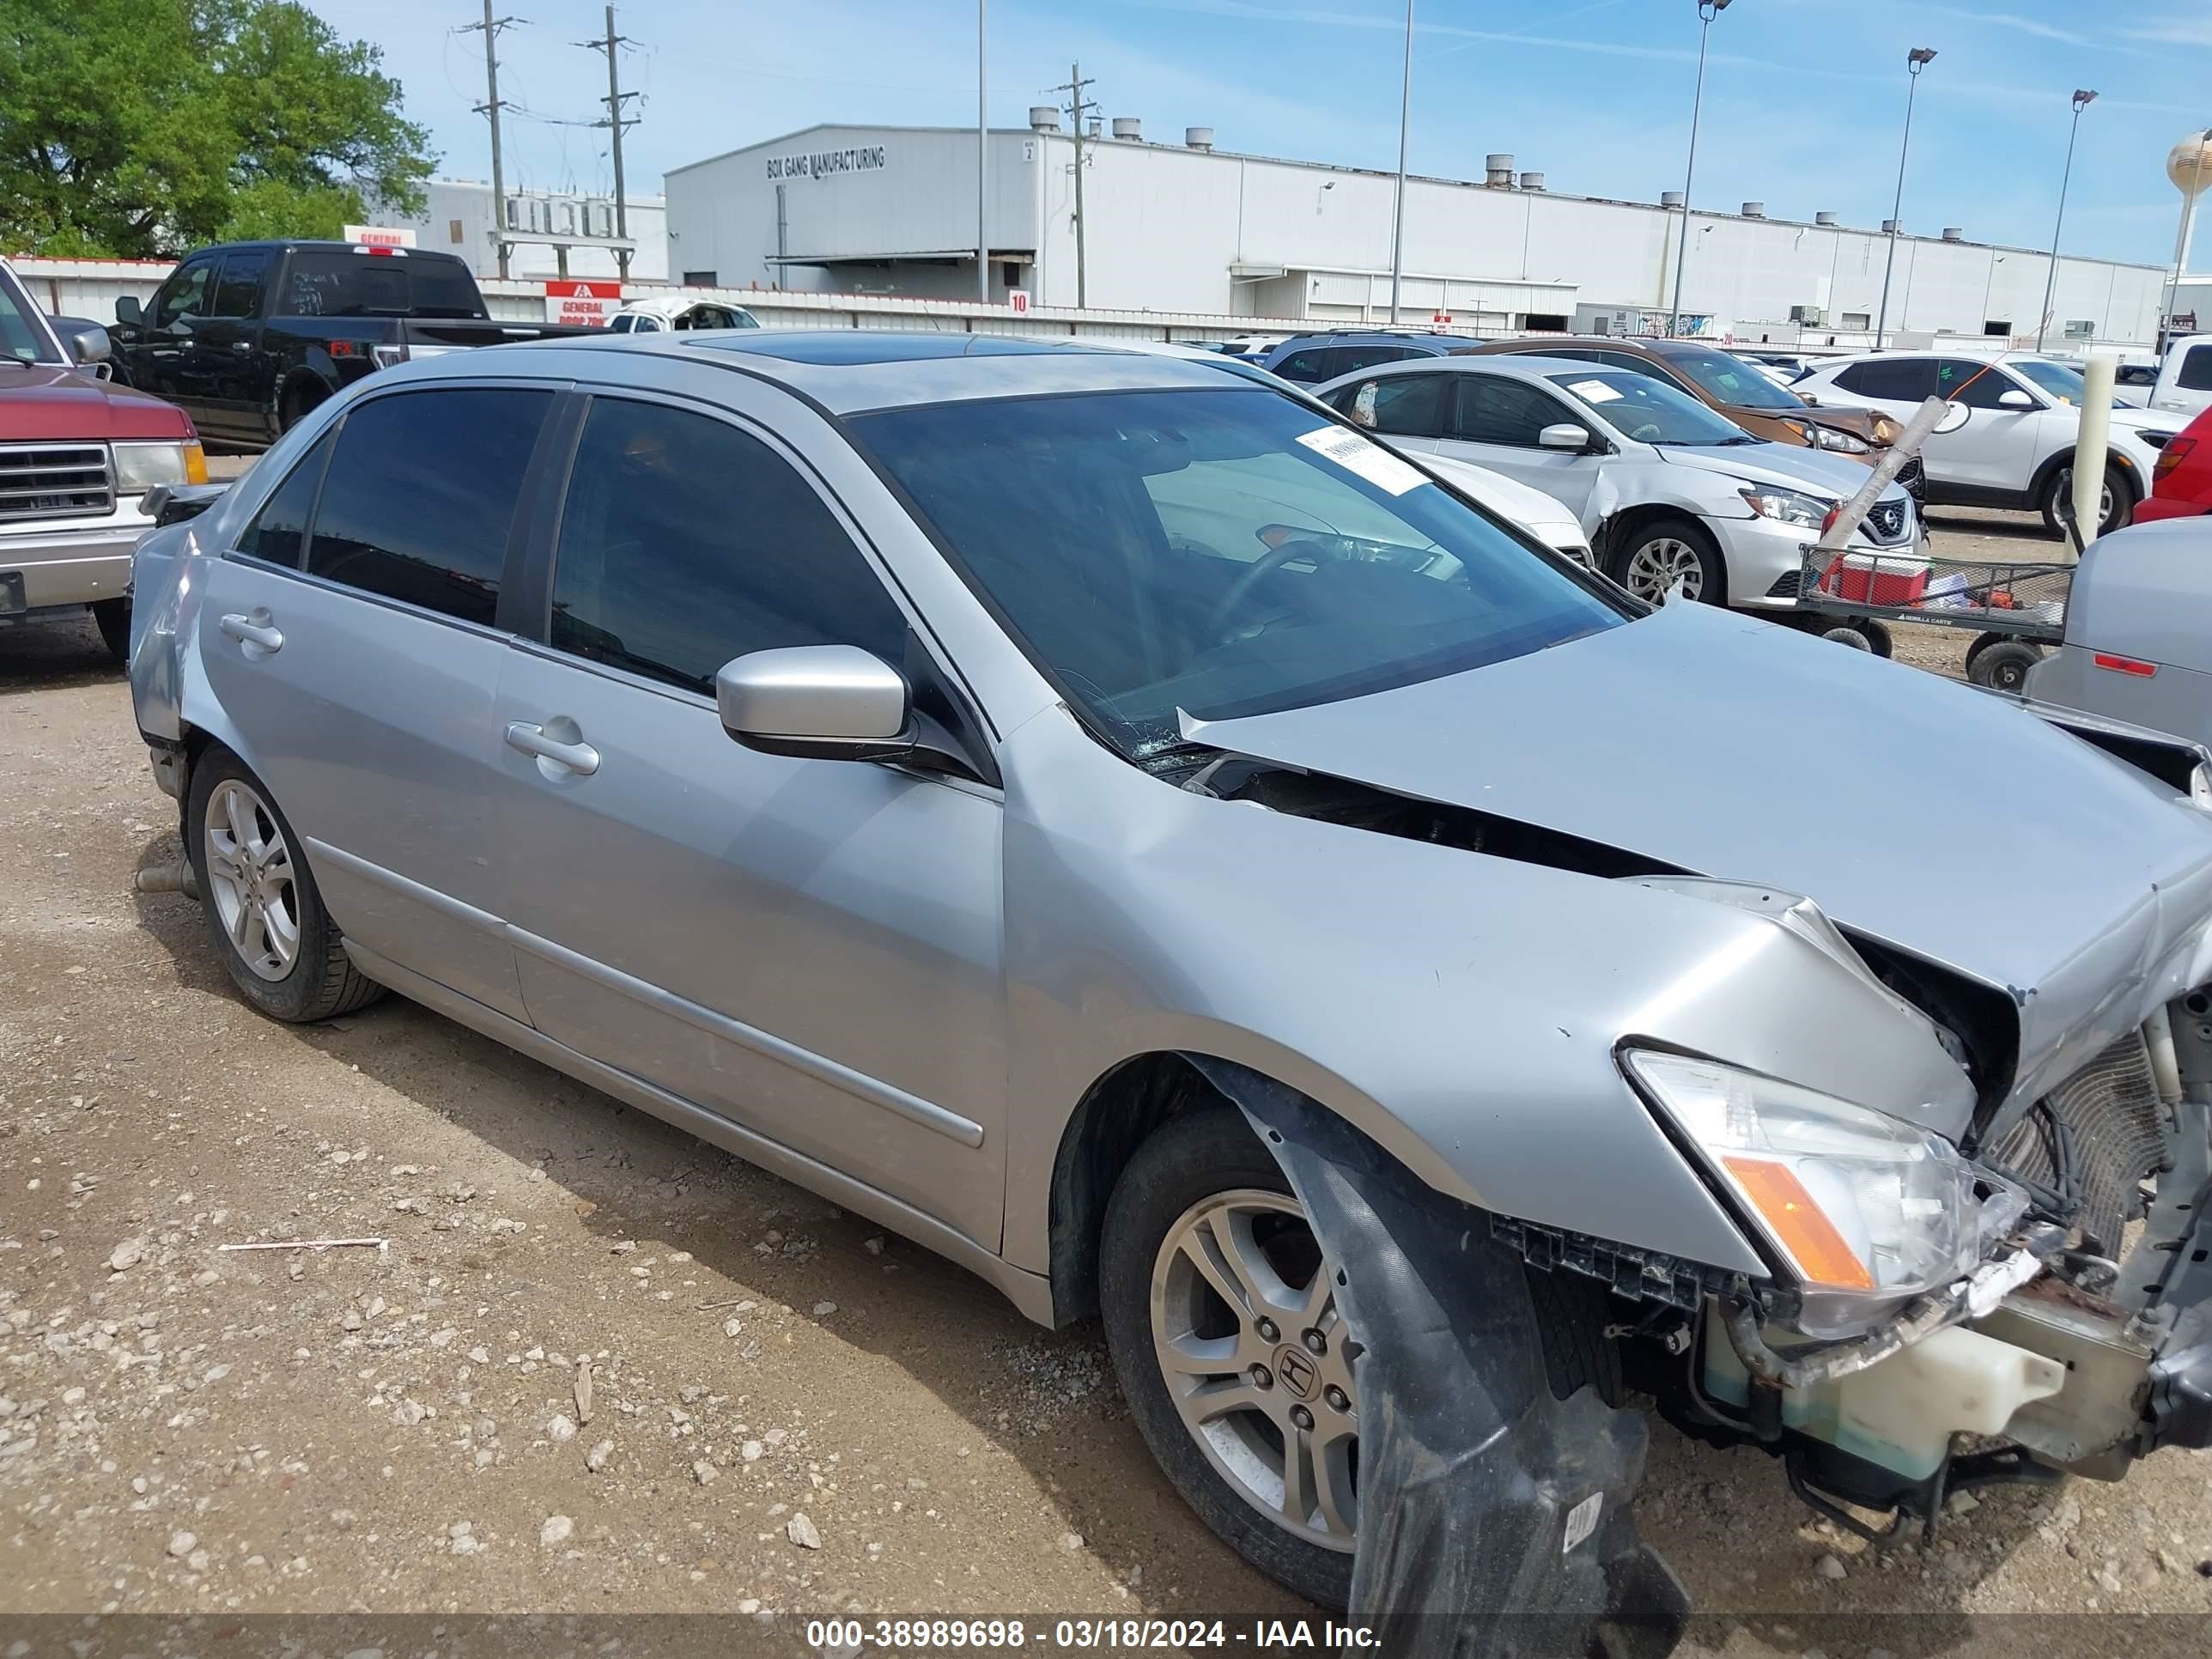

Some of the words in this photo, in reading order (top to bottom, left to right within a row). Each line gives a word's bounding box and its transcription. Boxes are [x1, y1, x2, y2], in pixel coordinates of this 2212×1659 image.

[768, 158, 784, 179] BOX
[785, 155, 808, 177] GANG
[810, 146, 884, 174] MANUFACTURING
[361, 233, 402, 246] GENERAL
[562, 301, 603, 313] GENERAL
[1012, 295, 1027, 313] 10
